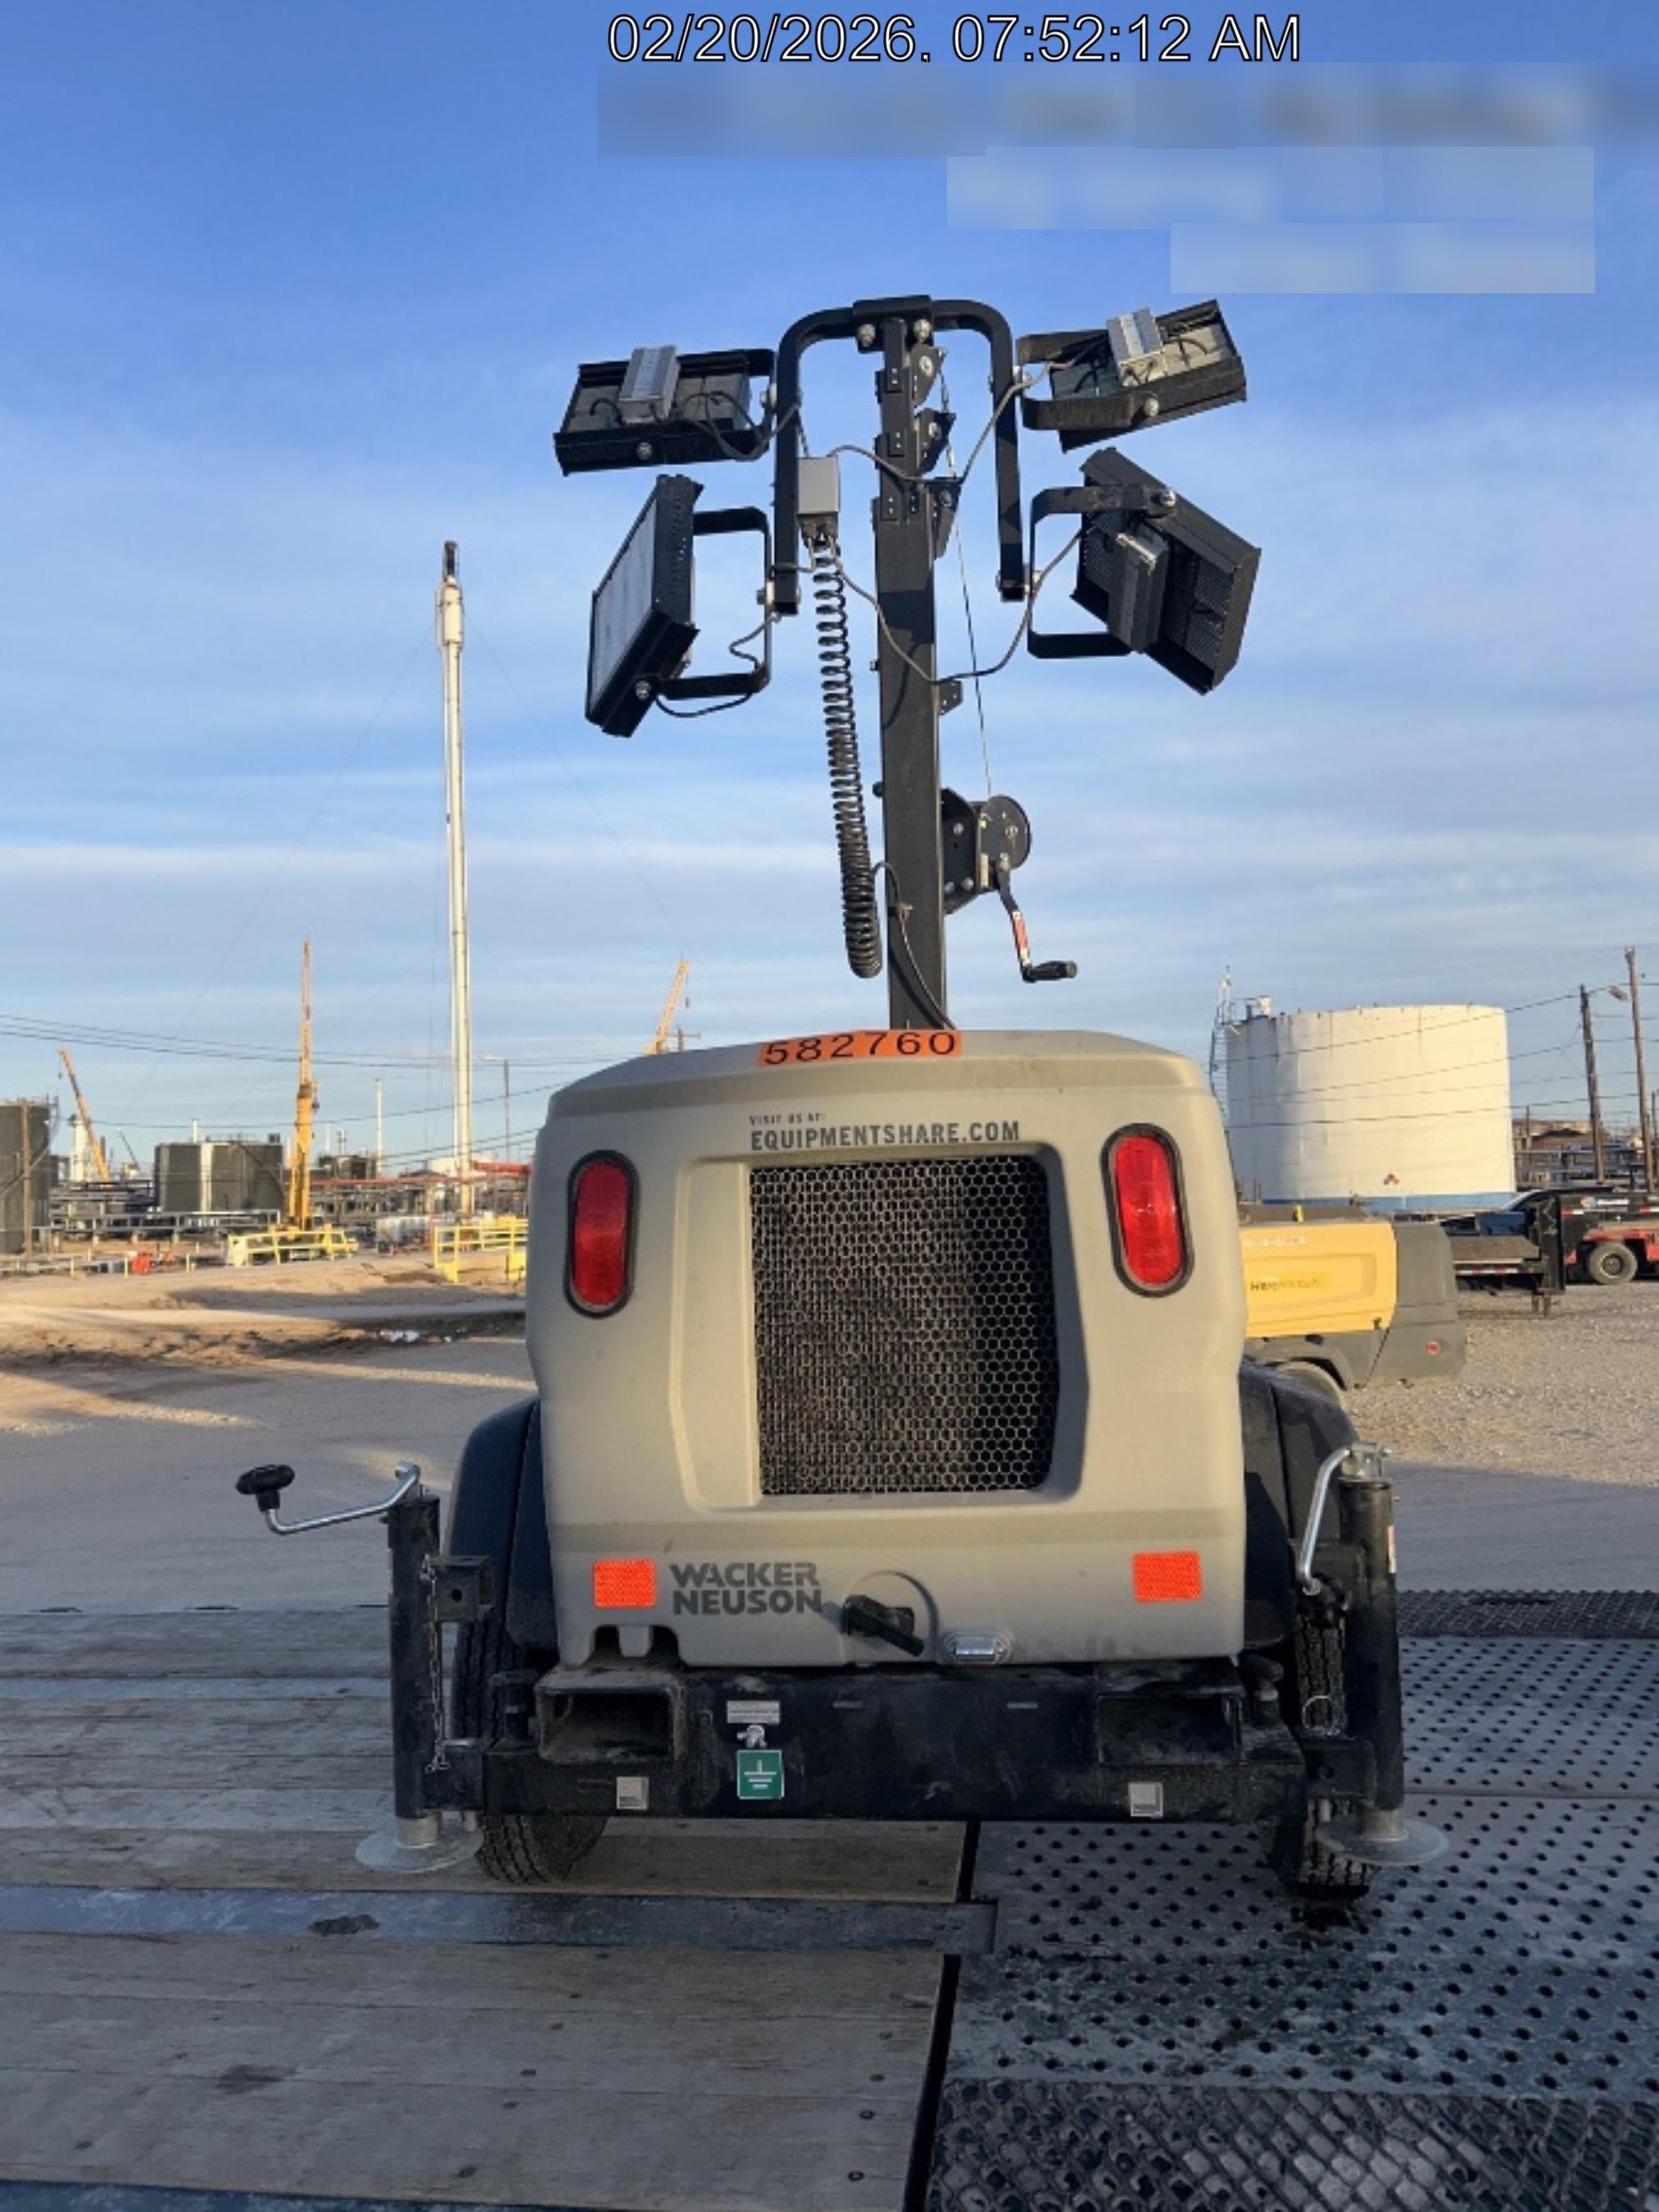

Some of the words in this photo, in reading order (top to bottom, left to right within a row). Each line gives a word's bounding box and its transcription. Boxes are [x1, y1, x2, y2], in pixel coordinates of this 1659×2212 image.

[764, 1031, 957, 1065] 582760
[750, 1120, 1020, 1151] EQUIPMENTSHARE.COM
[669, 1562, 820, 1588] WACKER
[673, 1589, 823, 1616] NEUSON
